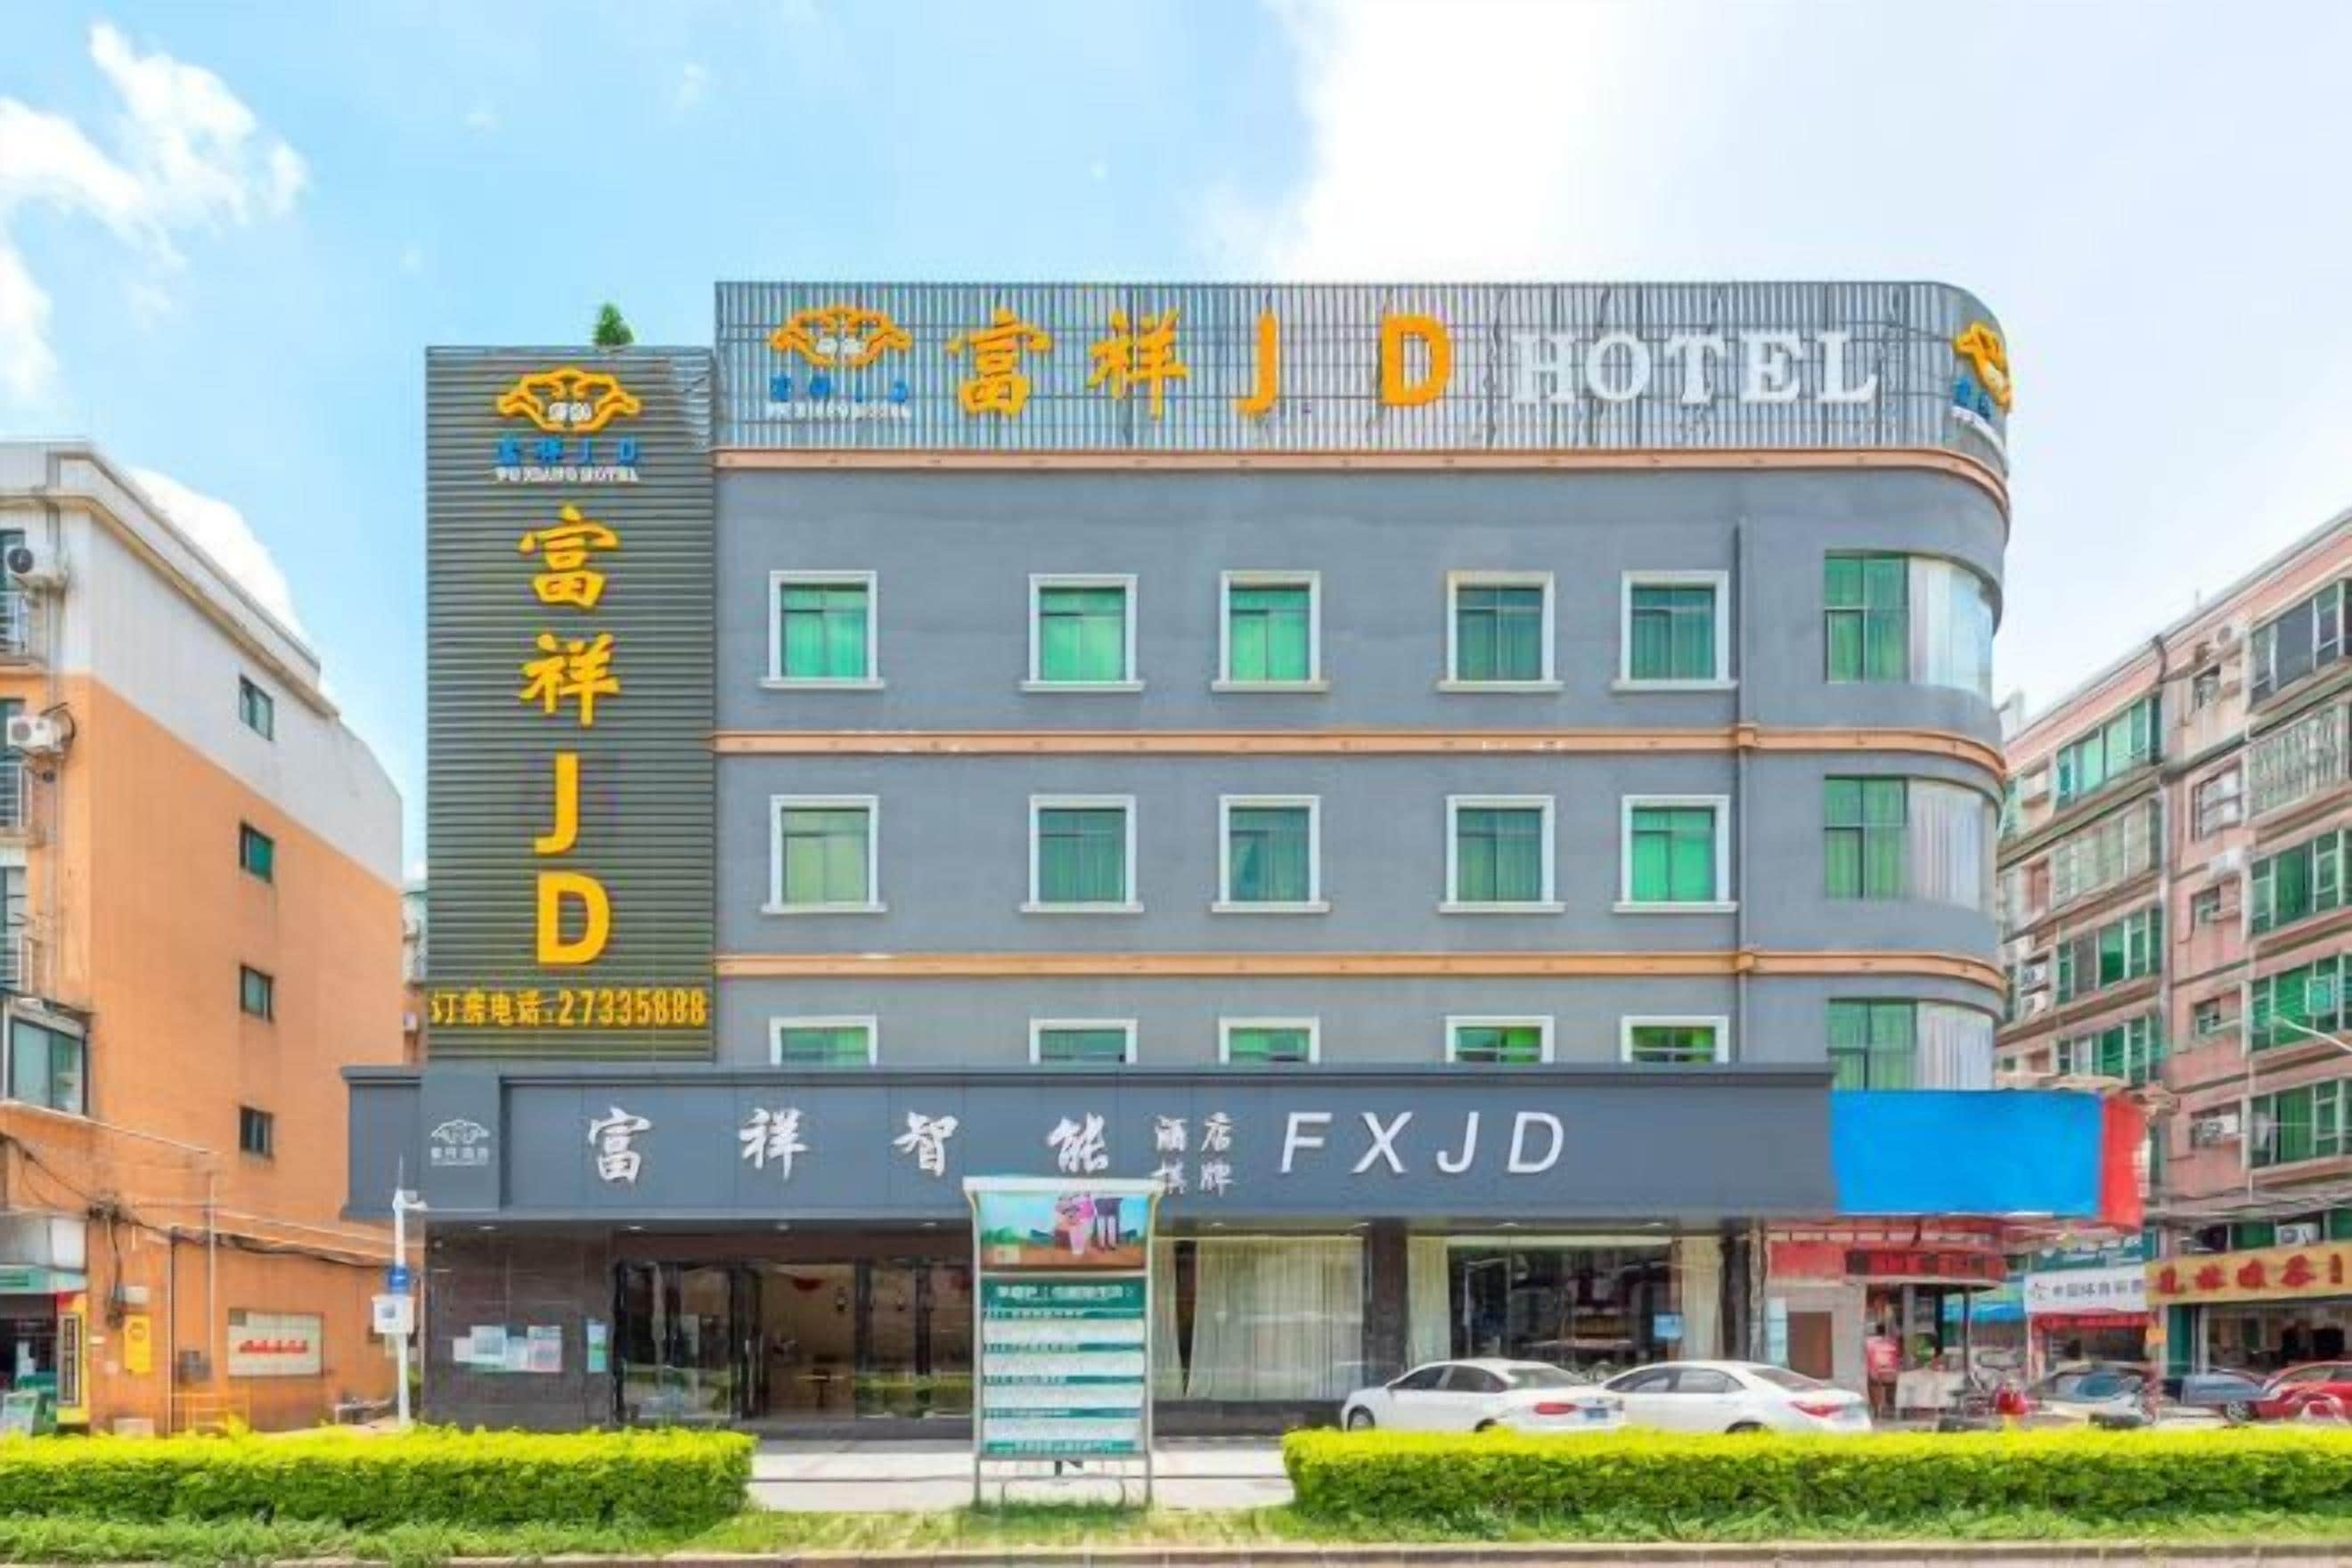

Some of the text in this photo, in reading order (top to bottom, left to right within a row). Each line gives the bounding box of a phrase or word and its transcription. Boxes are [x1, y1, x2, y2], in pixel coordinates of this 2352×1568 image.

[947, 308, 1188, 419] 富祥
[1512, 330, 1879, 406] HOTEL
[518, 504, 620, 728] 富祥
[587, 1107, 1564, 1184] 富祥智能 FXJD
[1154, 1111, 1233, 1152] 酒店
